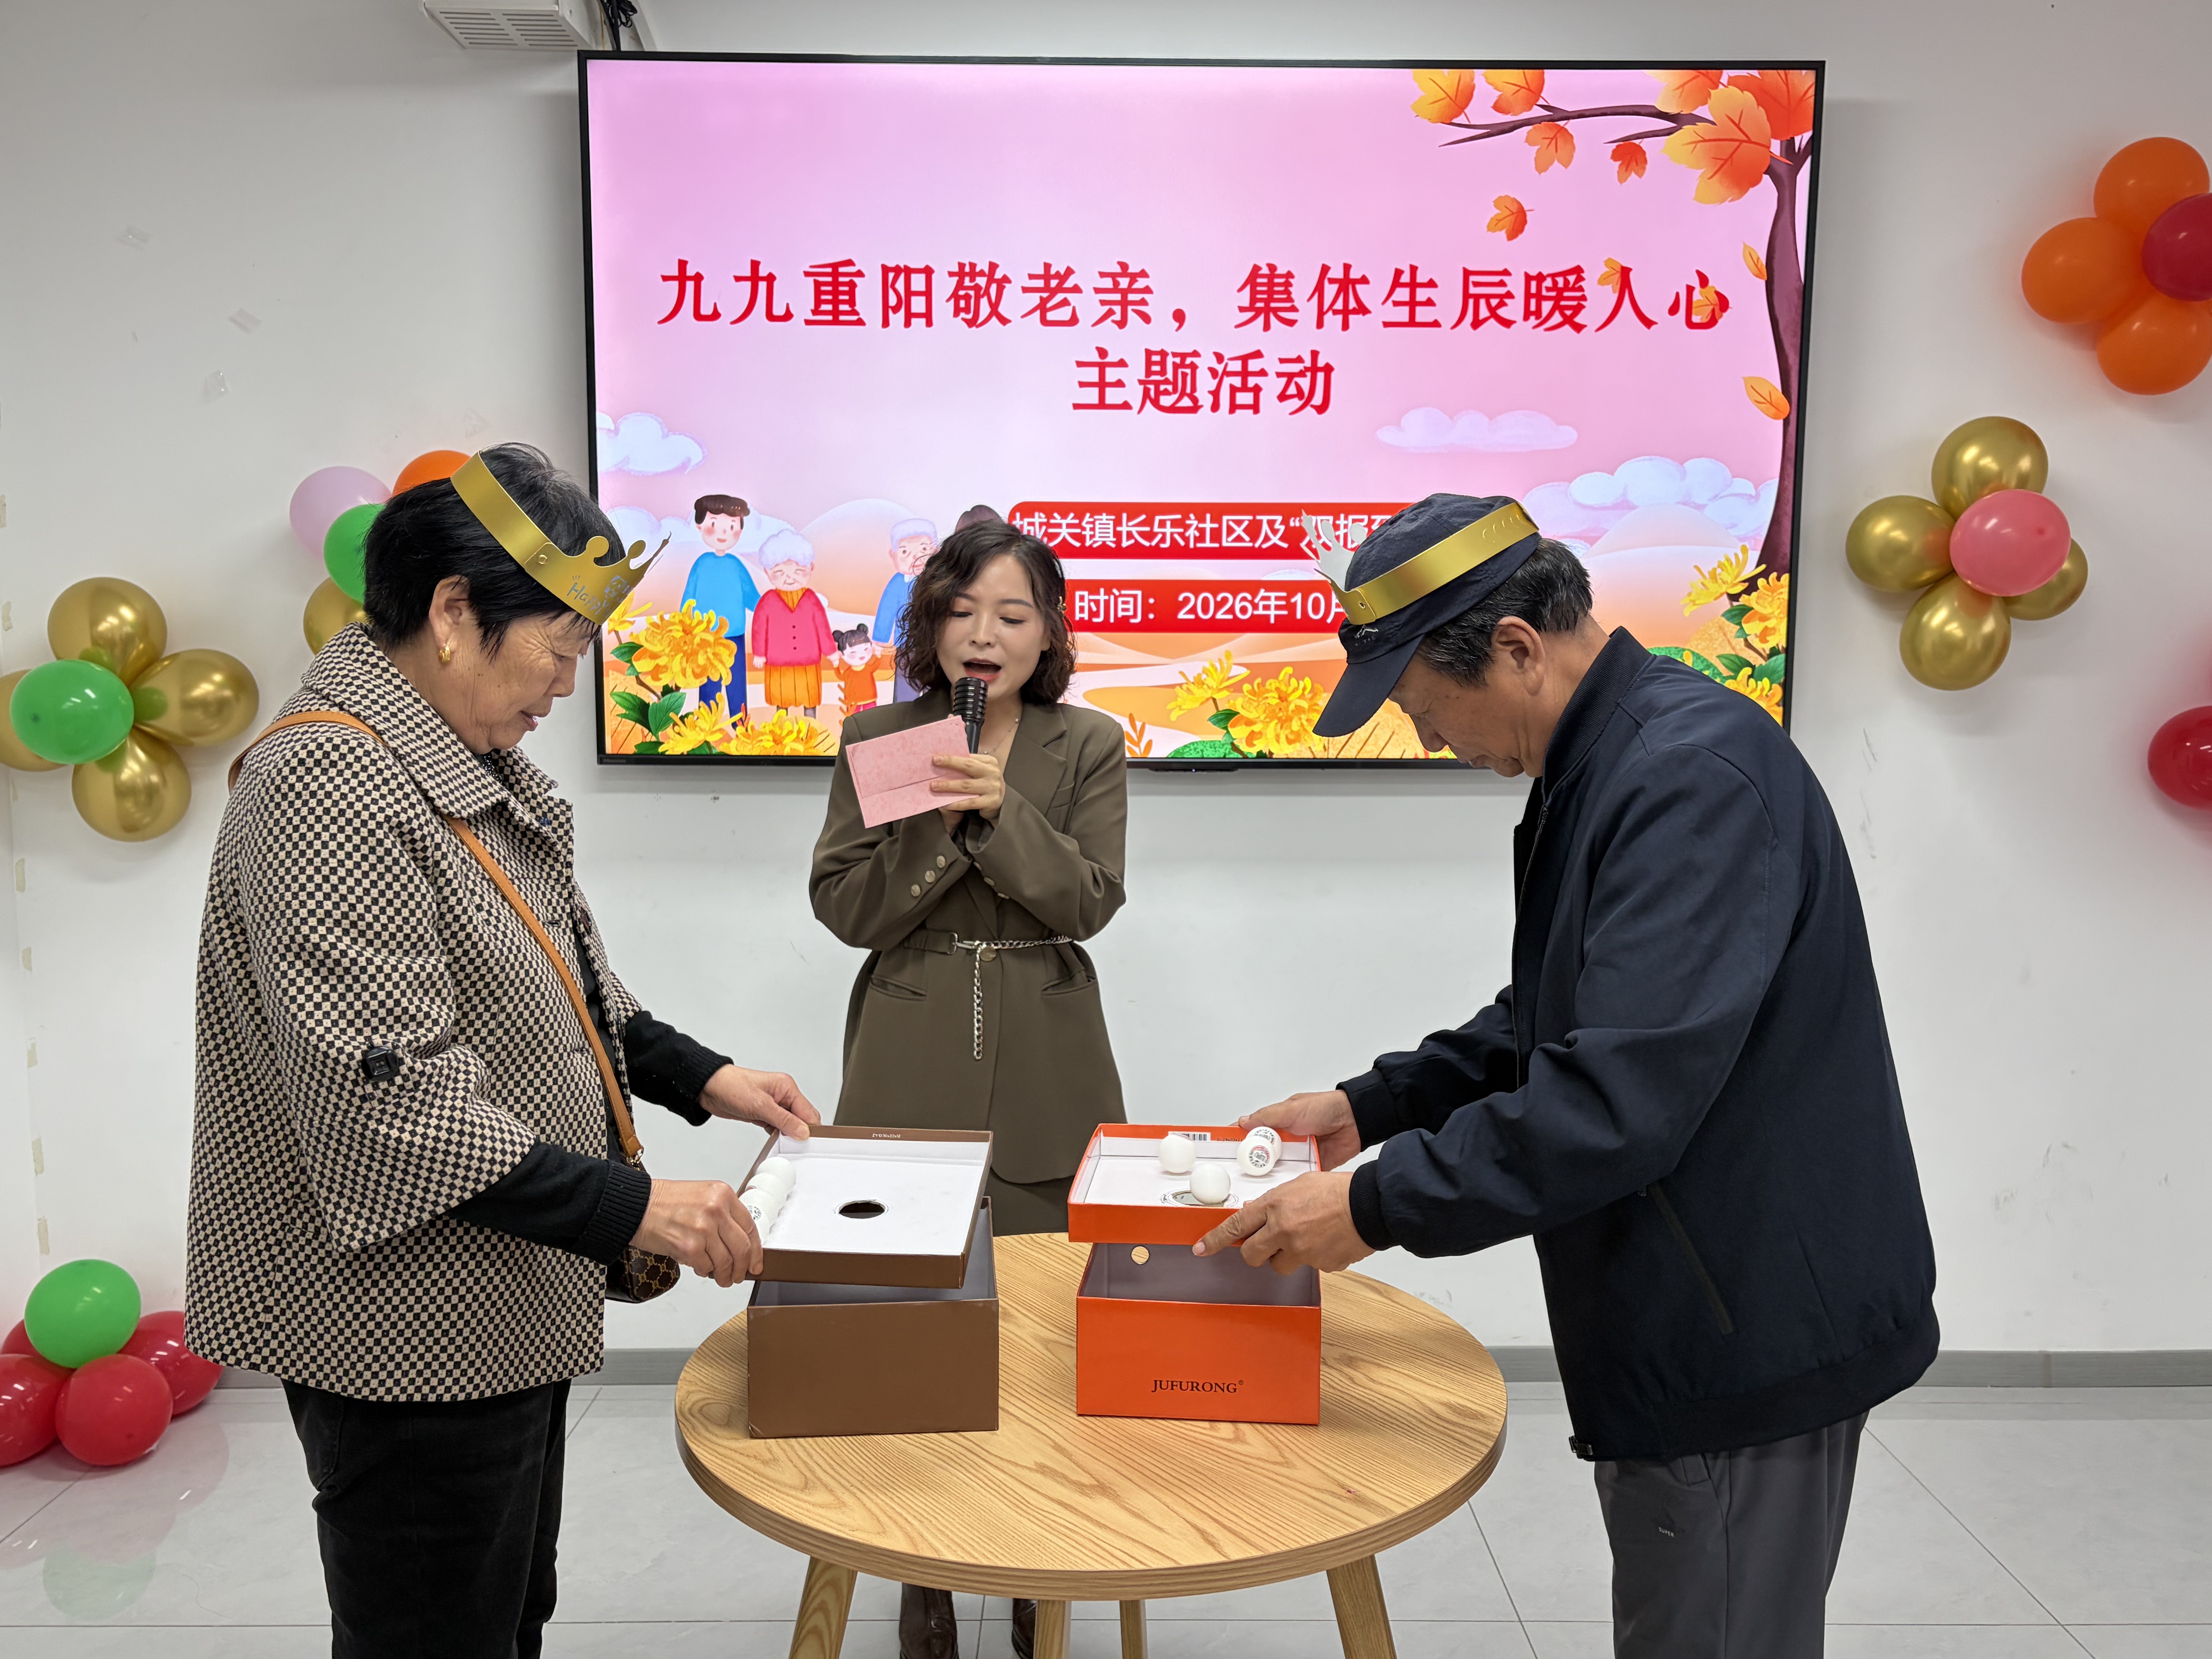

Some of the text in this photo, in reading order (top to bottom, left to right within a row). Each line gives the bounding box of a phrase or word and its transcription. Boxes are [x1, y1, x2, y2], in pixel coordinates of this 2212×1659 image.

[658, 259, 1729, 334] 九九重阳敬老亲，集体生辰暖人心
[1073, 347, 1334, 415] 主题活动
[1012, 512, 1392, 548] 城关镇长乐社区及“双报
[1151, 1380, 1237, 1393] JUFURONG
